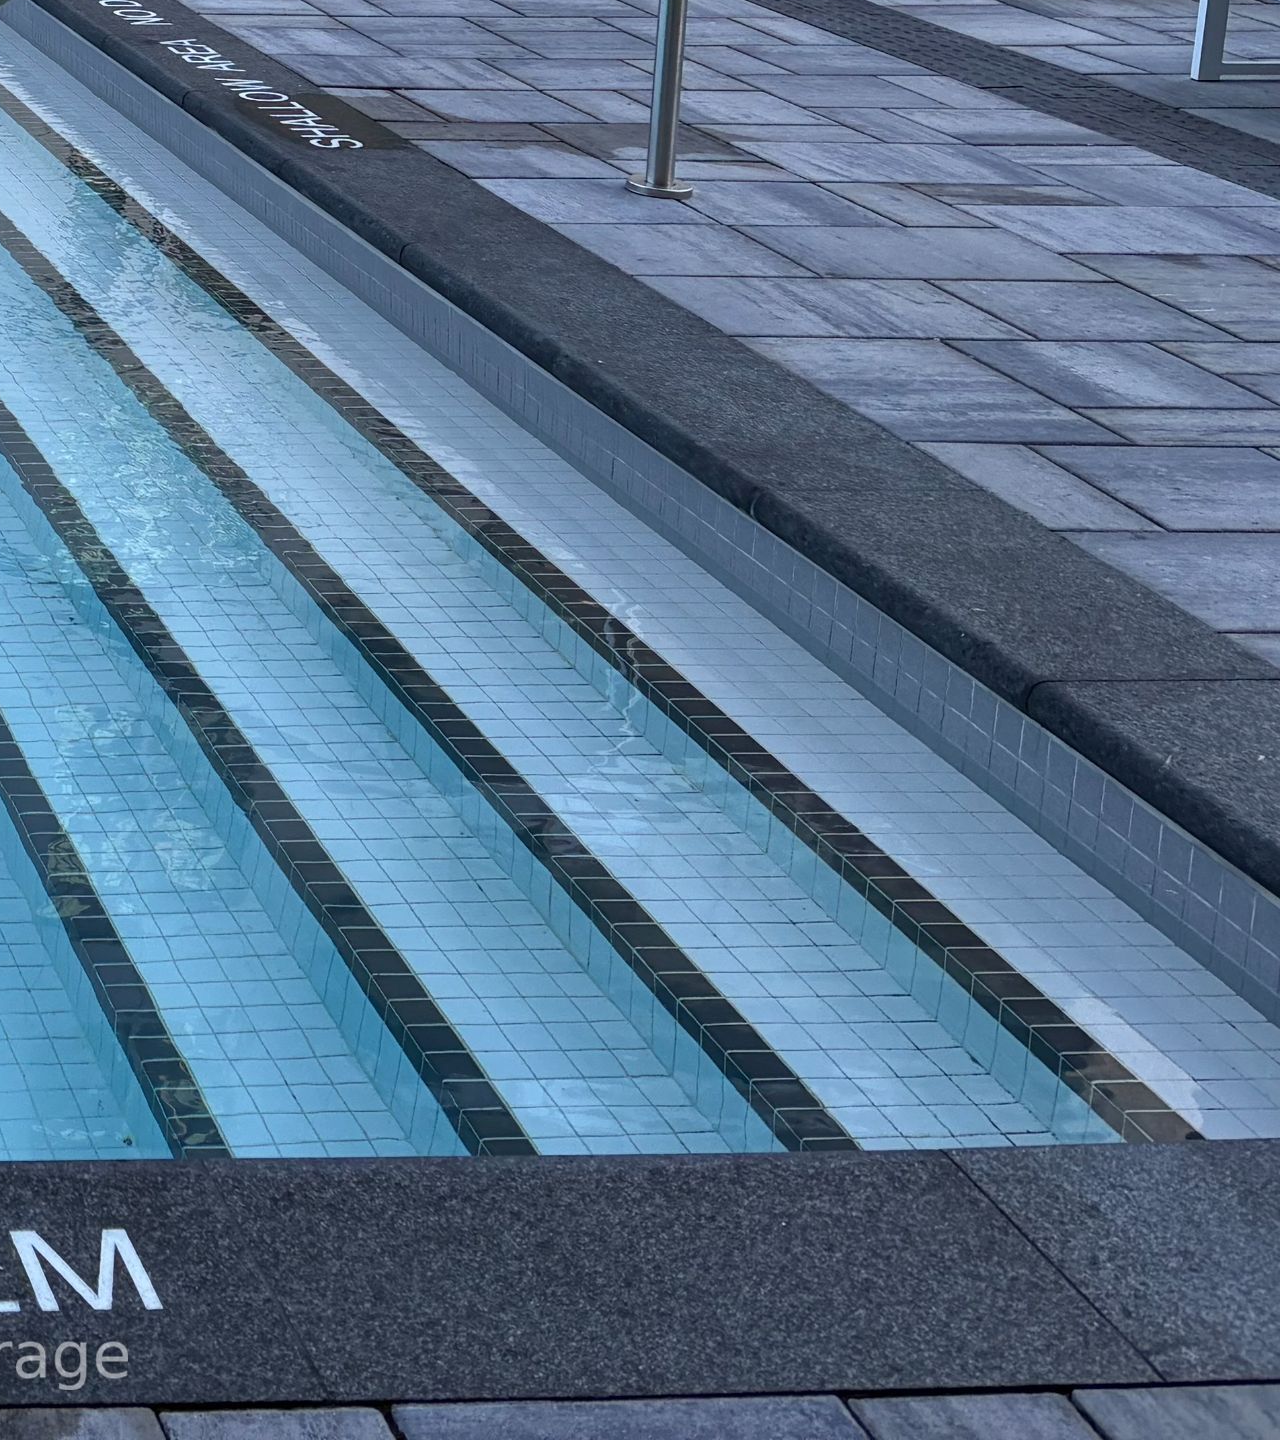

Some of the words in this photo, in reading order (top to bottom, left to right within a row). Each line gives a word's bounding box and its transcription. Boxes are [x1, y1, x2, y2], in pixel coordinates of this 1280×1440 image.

[112, 9, 174, 26] NO
[159, 38, 246, 72] AREA
[214, 77, 364, 150] SHALLOW
